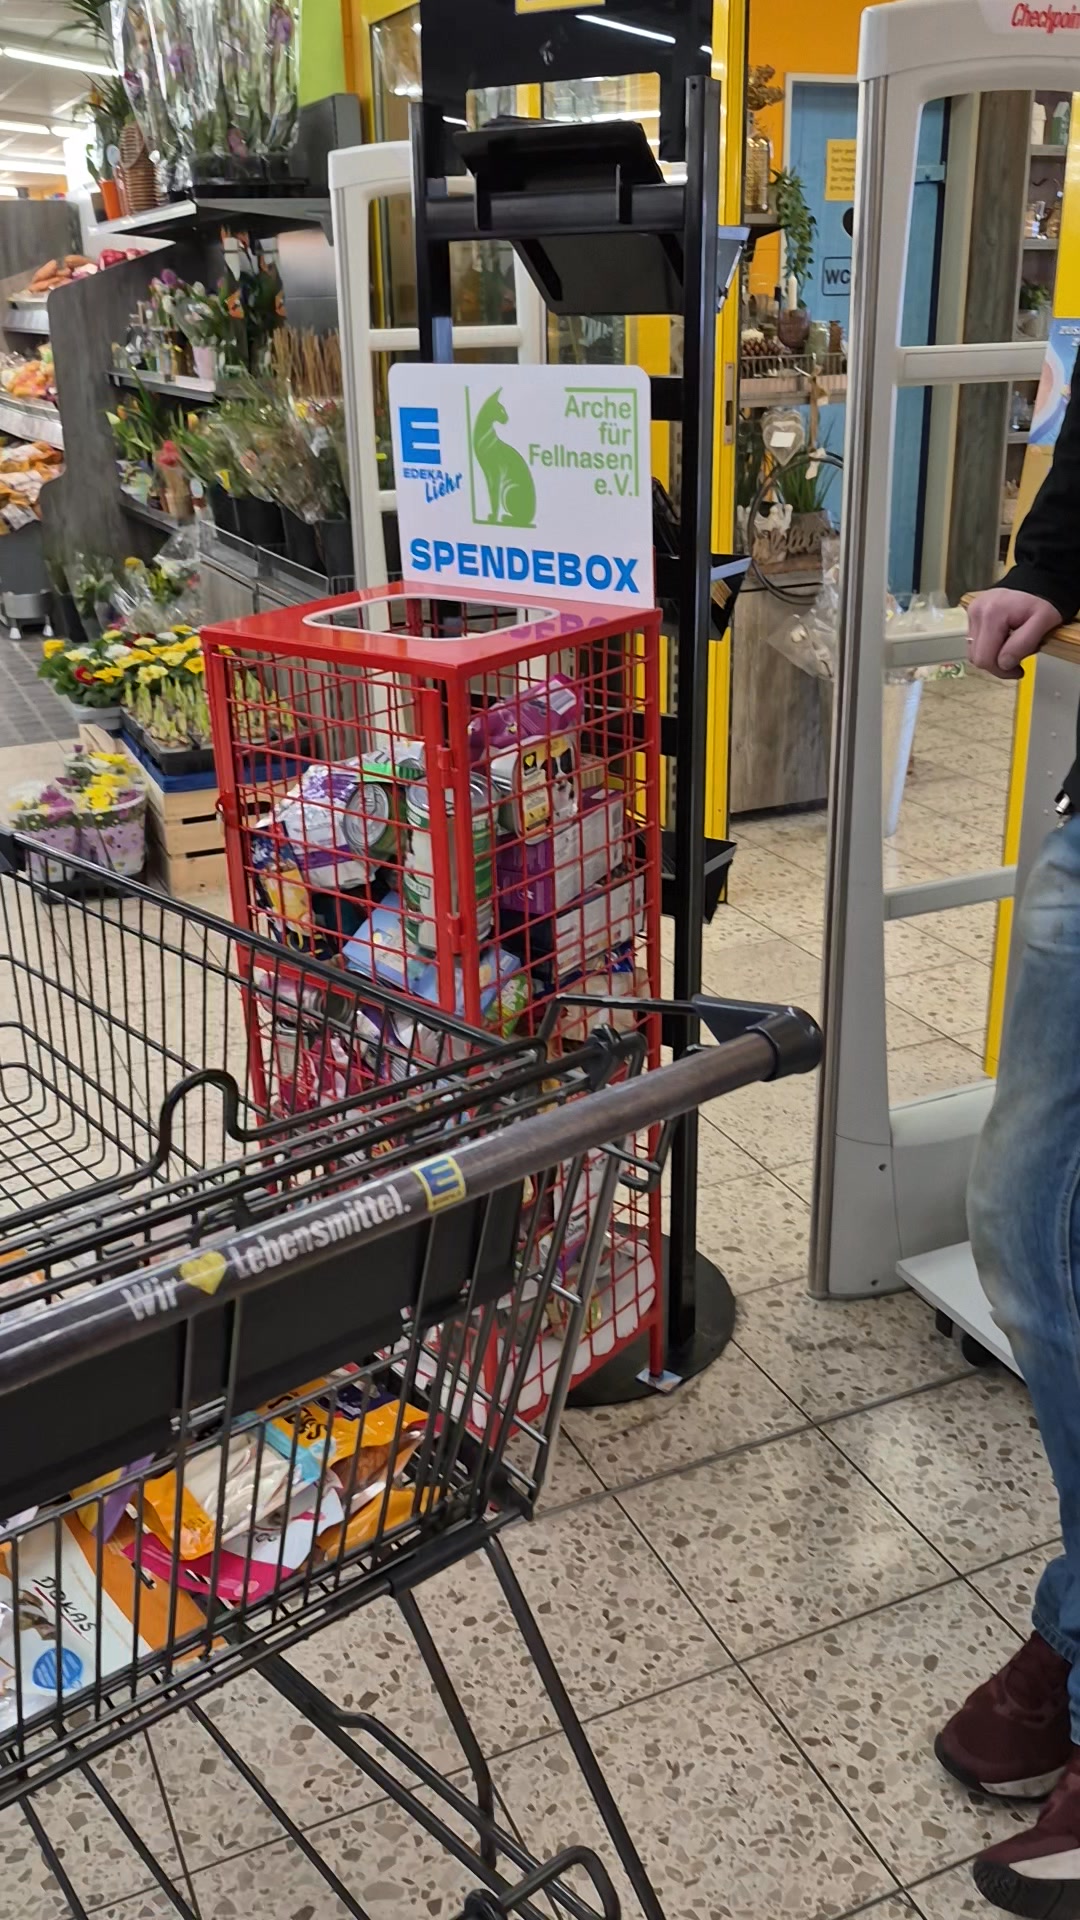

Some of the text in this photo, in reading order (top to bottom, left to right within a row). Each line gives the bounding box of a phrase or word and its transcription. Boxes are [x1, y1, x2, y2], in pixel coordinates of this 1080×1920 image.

[825, 268, 851, 285] WC
[564, 394, 632, 419] Arche
[598, 423, 632, 446] für
[529, 443, 633, 471] Fellnasen
[402, 467, 443, 481] EDEKA
[594, 473, 634, 497] e.V.
[410, 537, 640, 594] SPENDEBOX
[120, 1182, 411, 1322] Wir Lebensmittel.
